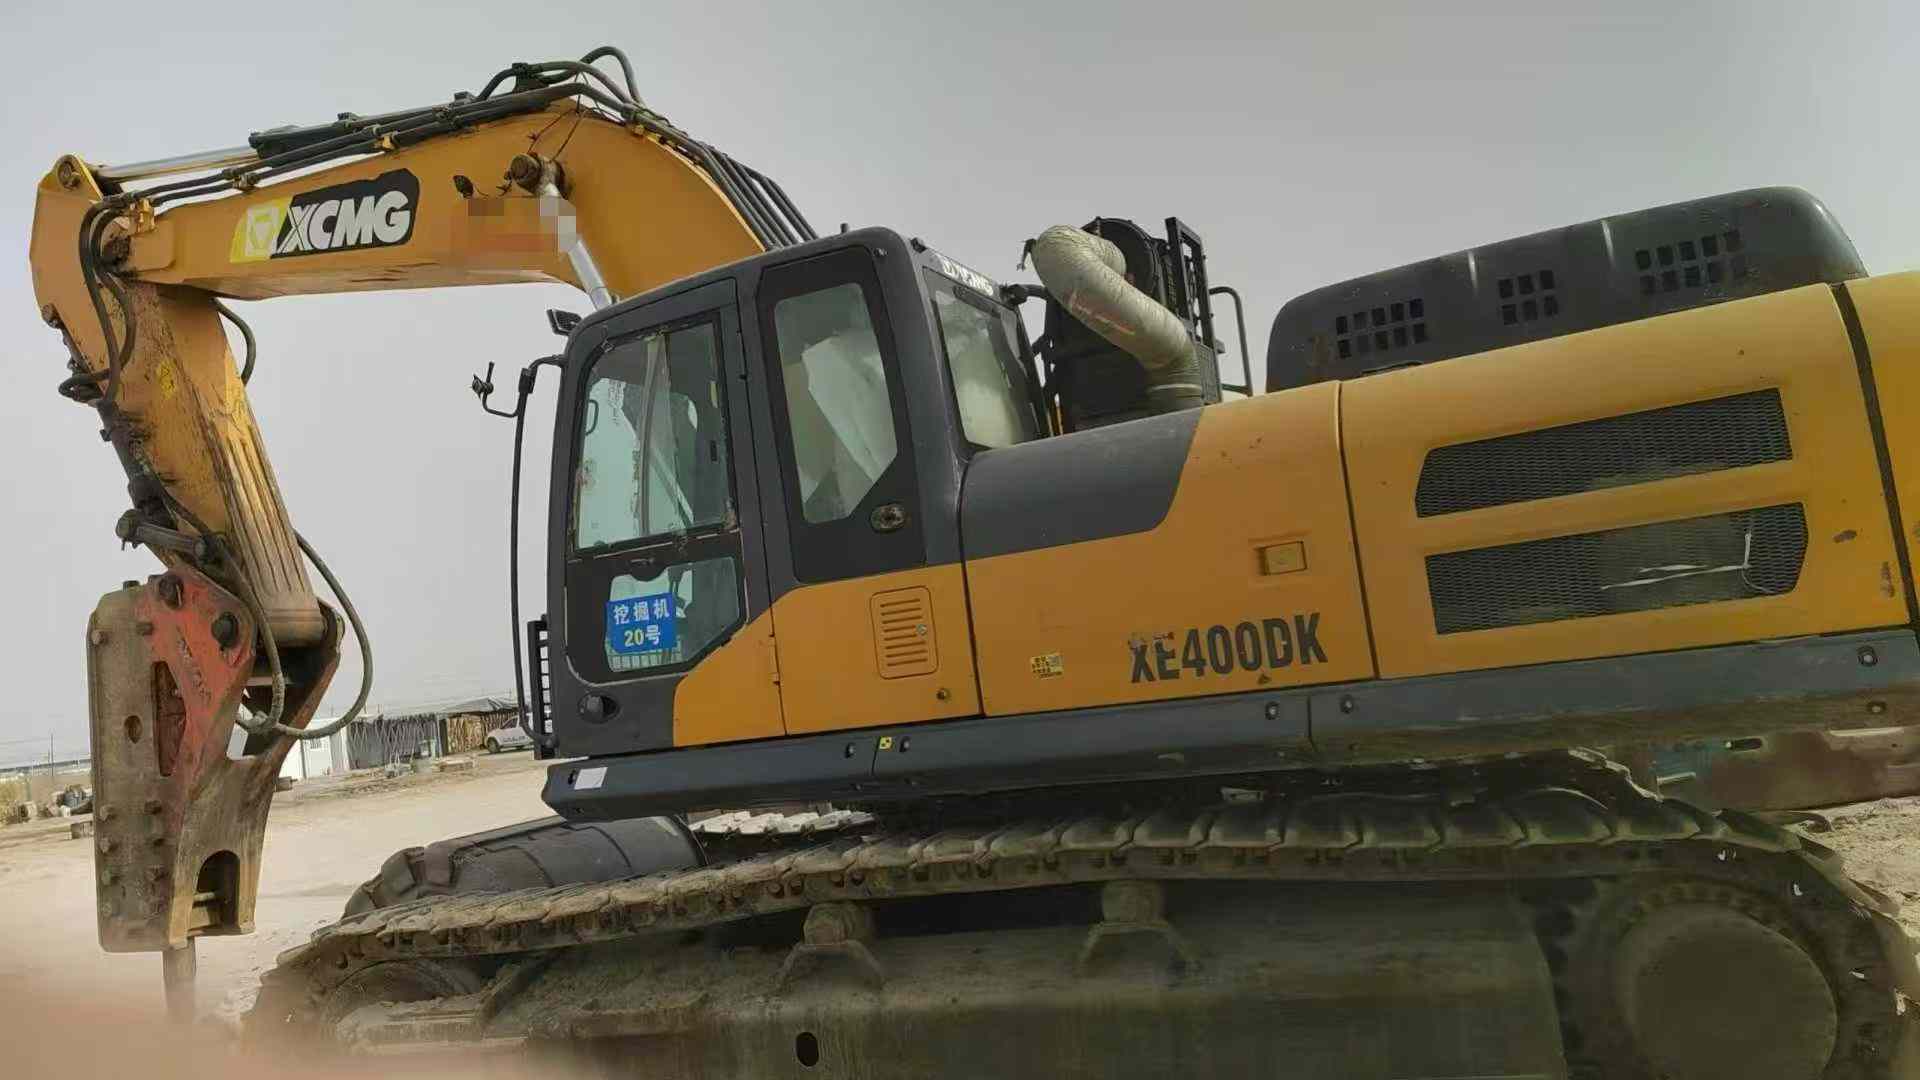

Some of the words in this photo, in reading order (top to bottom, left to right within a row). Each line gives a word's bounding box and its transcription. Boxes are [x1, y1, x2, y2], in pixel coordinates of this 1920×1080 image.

[277, 190, 412, 254] XCMG
[613, 598, 670, 625] 挖掘机
[624, 624, 662, 647] 20号
[1129, 612, 1328, 684] XE400DK
